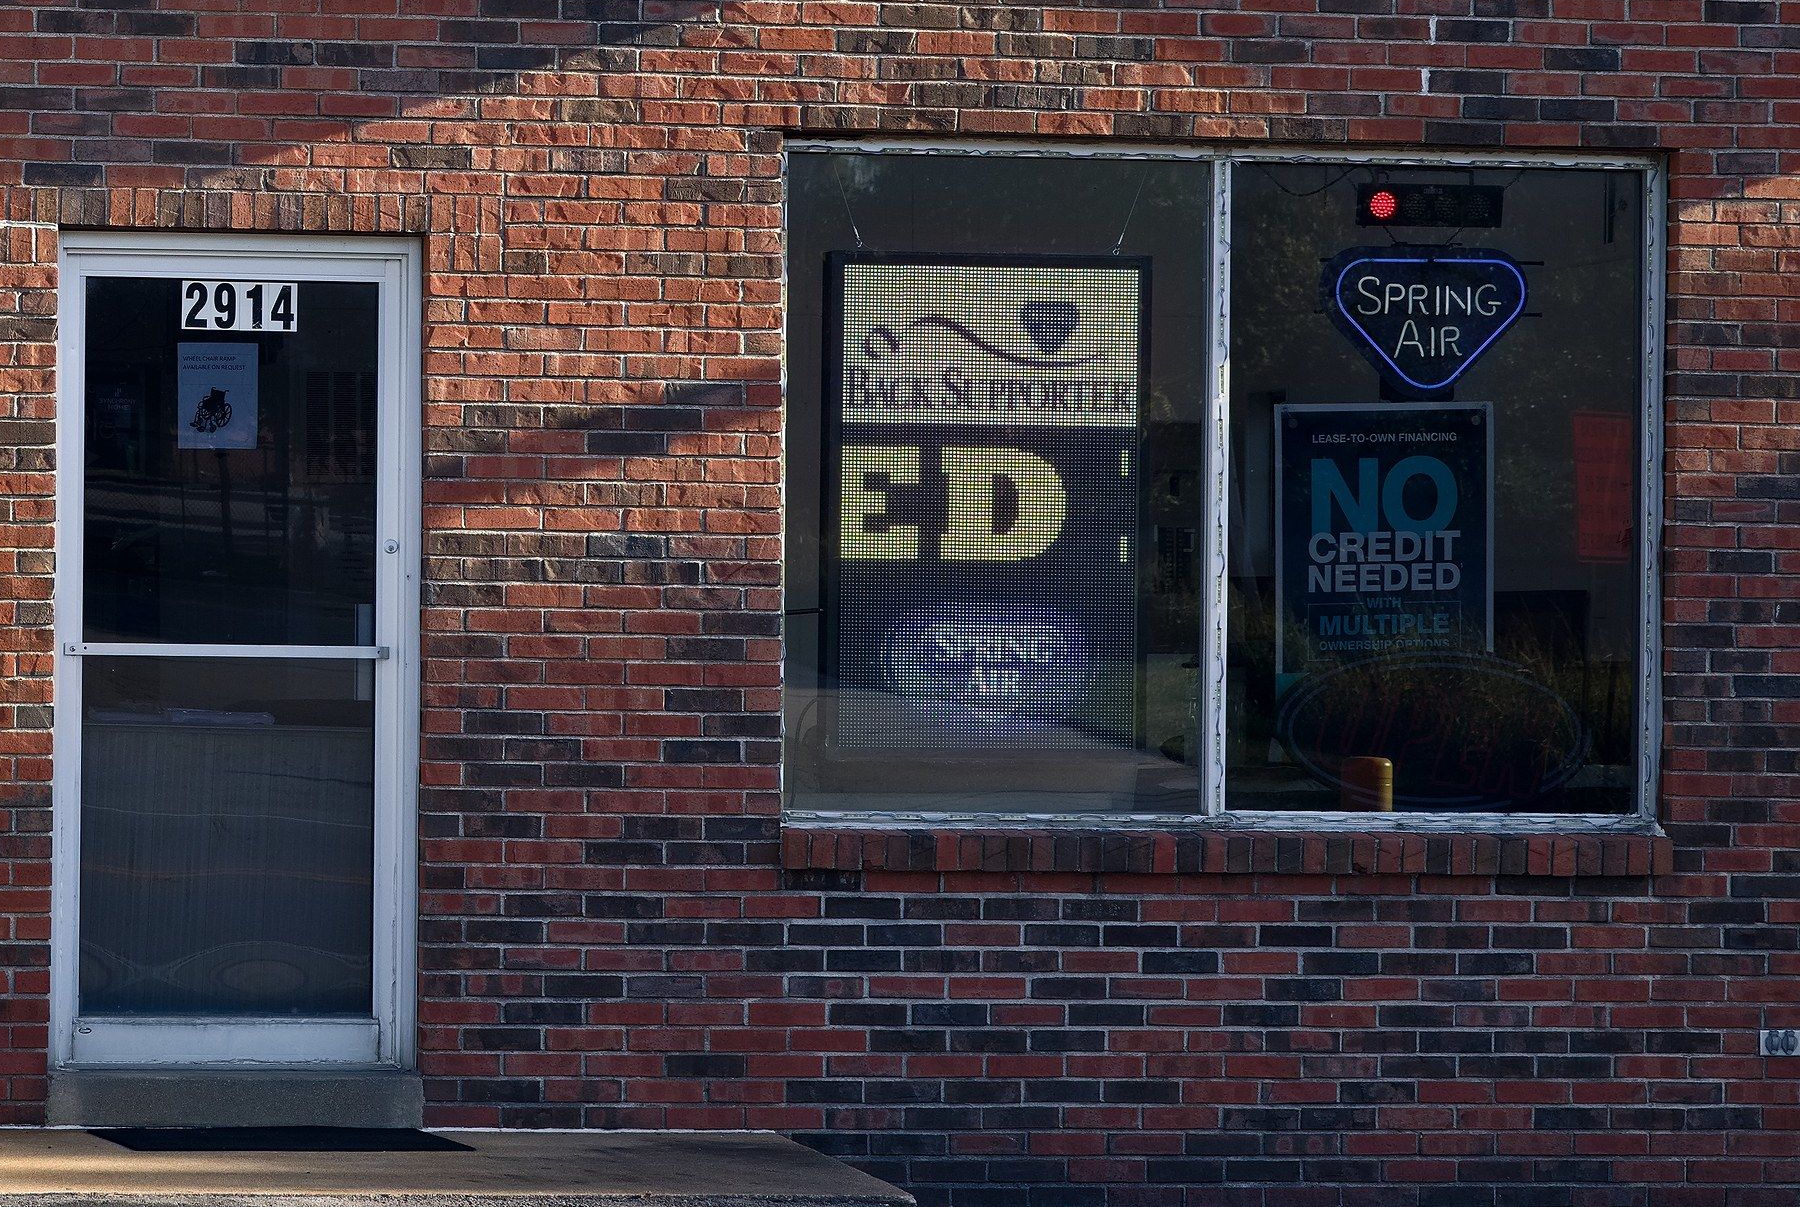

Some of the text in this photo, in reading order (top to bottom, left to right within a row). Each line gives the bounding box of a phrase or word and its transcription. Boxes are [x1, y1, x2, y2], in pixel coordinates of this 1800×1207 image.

[185, 282, 294, 330] 2914
[1357, 275, 1502, 317] SPRING
[1393, 319, 1463, 359] AIR
[846, 366, 1132, 413] BACK SUPPORTER
[1312, 431, 1457, 444] LEASE-TO-OWN FINANCING
[1310, 455, 1458, 538] NO
[1308, 530, 1461, 563] CREDIT
[1308, 562, 1461, 593] NEEDED
[1366, 596, 1402, 609] WITH
[1319, 613, 1450, 636] MULTIPLE
[965, 666, 1020, 696] AIR
